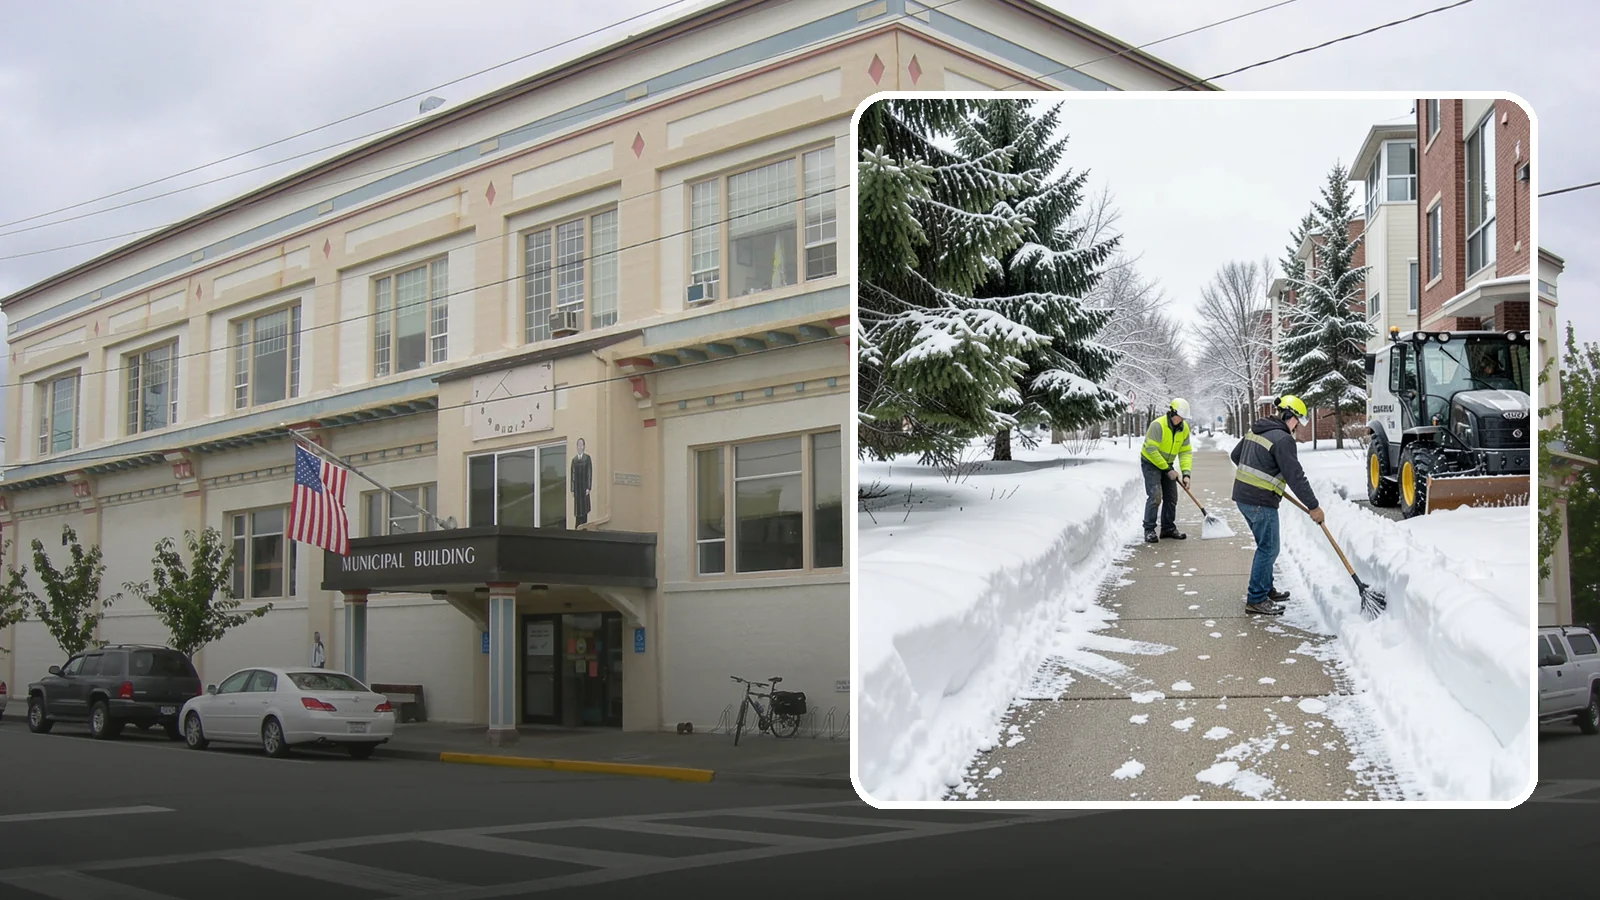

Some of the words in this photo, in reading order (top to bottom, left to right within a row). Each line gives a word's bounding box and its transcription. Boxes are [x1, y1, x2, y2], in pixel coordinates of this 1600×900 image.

[495, 424, 500, 432] 10
[508, 425, 513, 433] 12
[342, 552, 405, 572] MUNICIPAL
[414, 546, 475, 567] BUILDING
